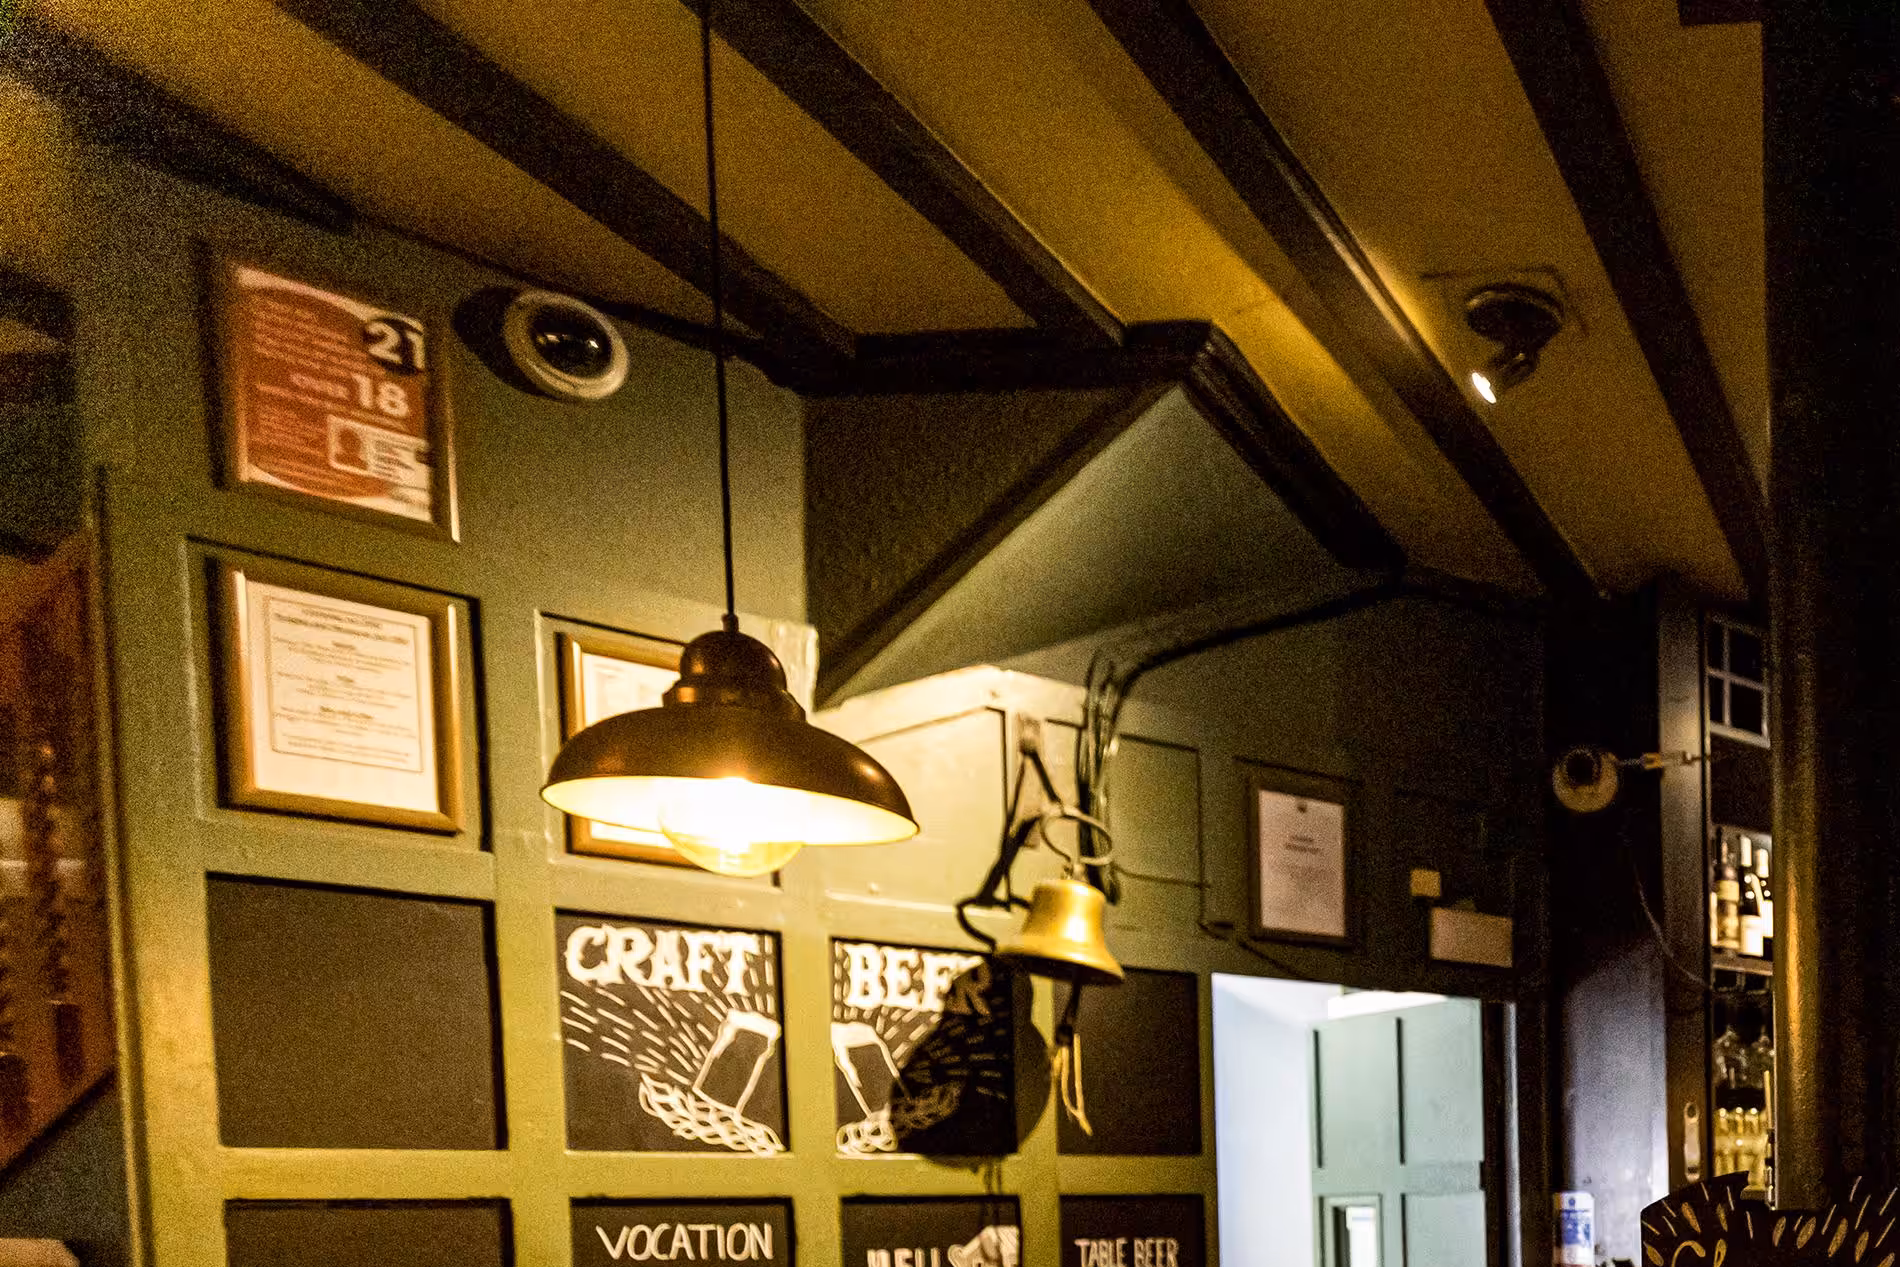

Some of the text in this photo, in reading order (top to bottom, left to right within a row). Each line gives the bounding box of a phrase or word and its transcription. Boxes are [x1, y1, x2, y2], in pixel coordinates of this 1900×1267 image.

[366, 321, 425, 370] 21
[350, 372, 408, 418] 18
[566, 924, 991, 1016] CRAFT BEER
[595, 1222, 774, 1261] VOCATION
